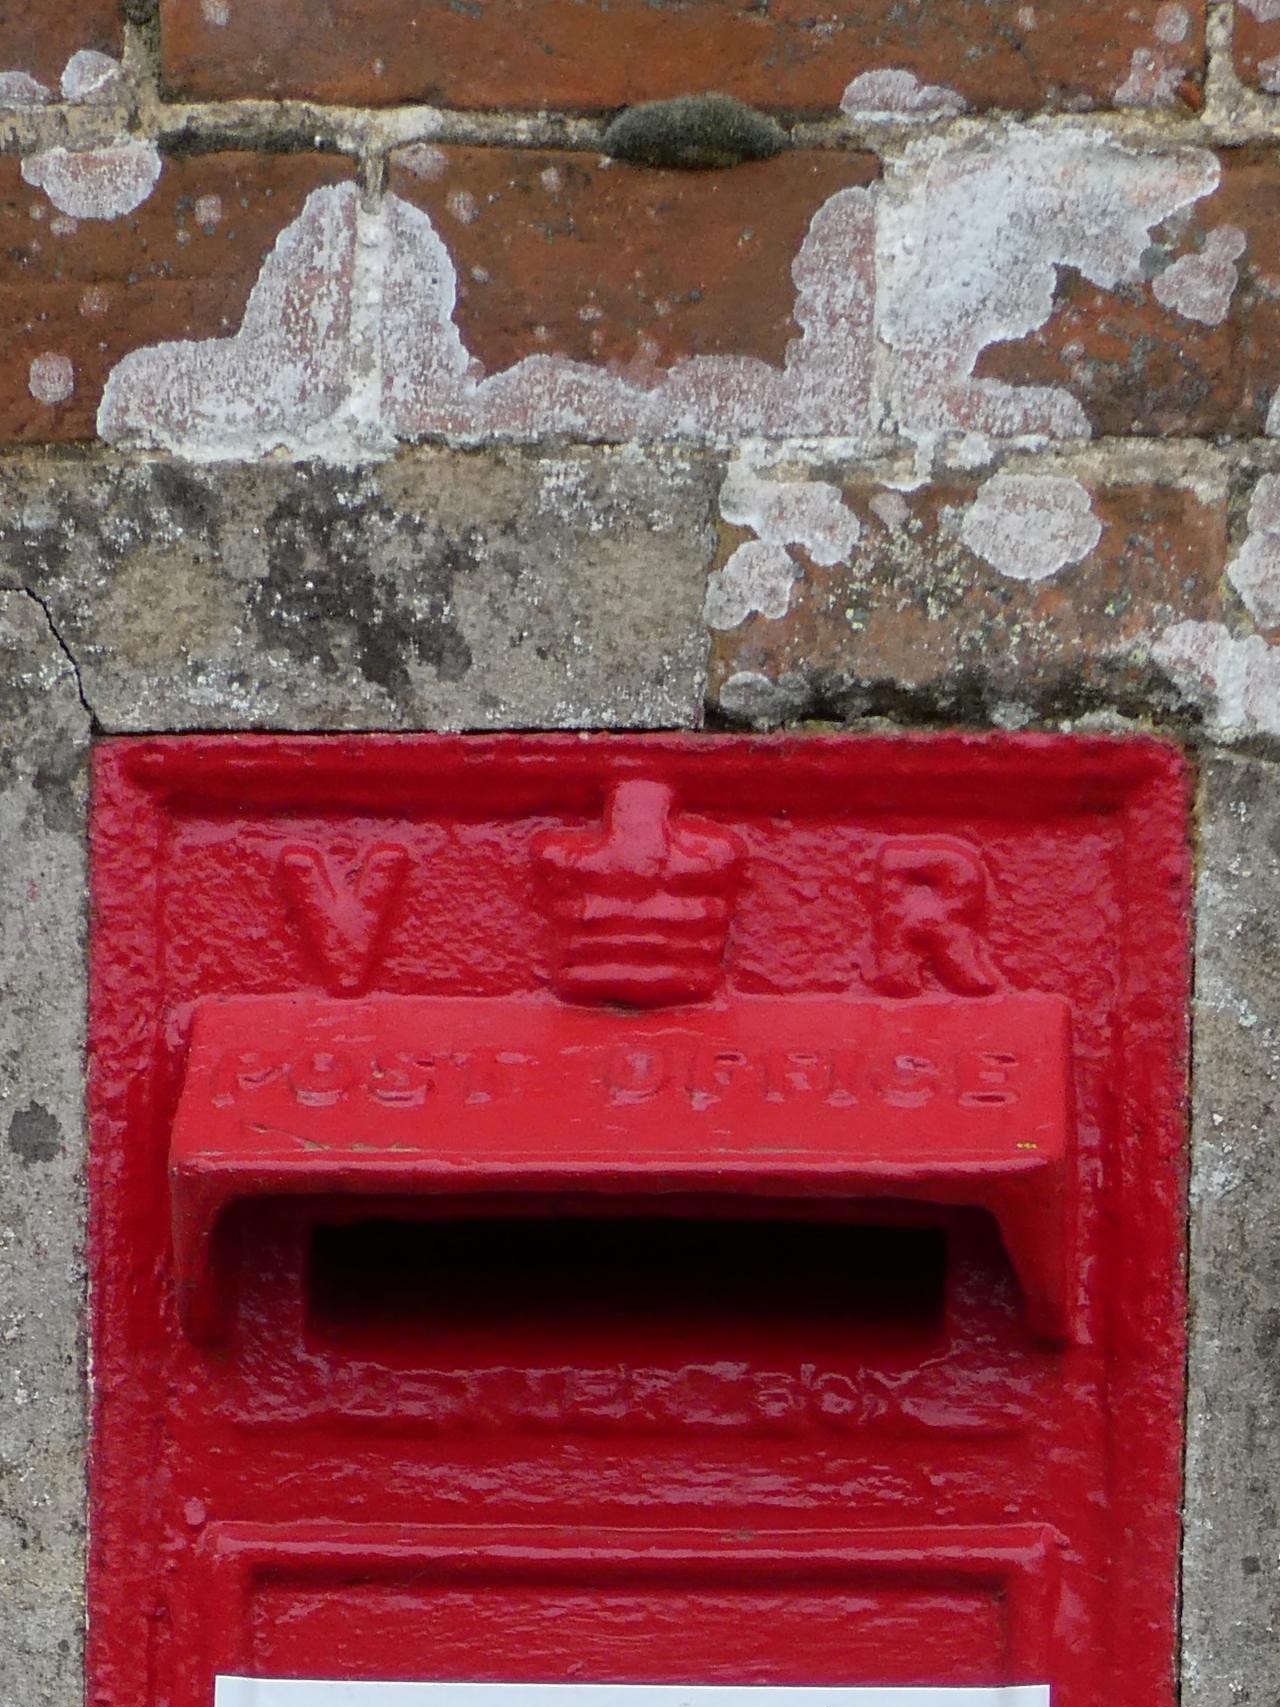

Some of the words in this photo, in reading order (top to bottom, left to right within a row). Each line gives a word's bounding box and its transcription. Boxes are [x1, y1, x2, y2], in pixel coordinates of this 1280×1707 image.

[277, 842, 411, 998] V
[866, 833, 1007, 999] R
[210, 1048, 532, 1108] POST
[602, 1047, 1020, 1111] OFFICE
